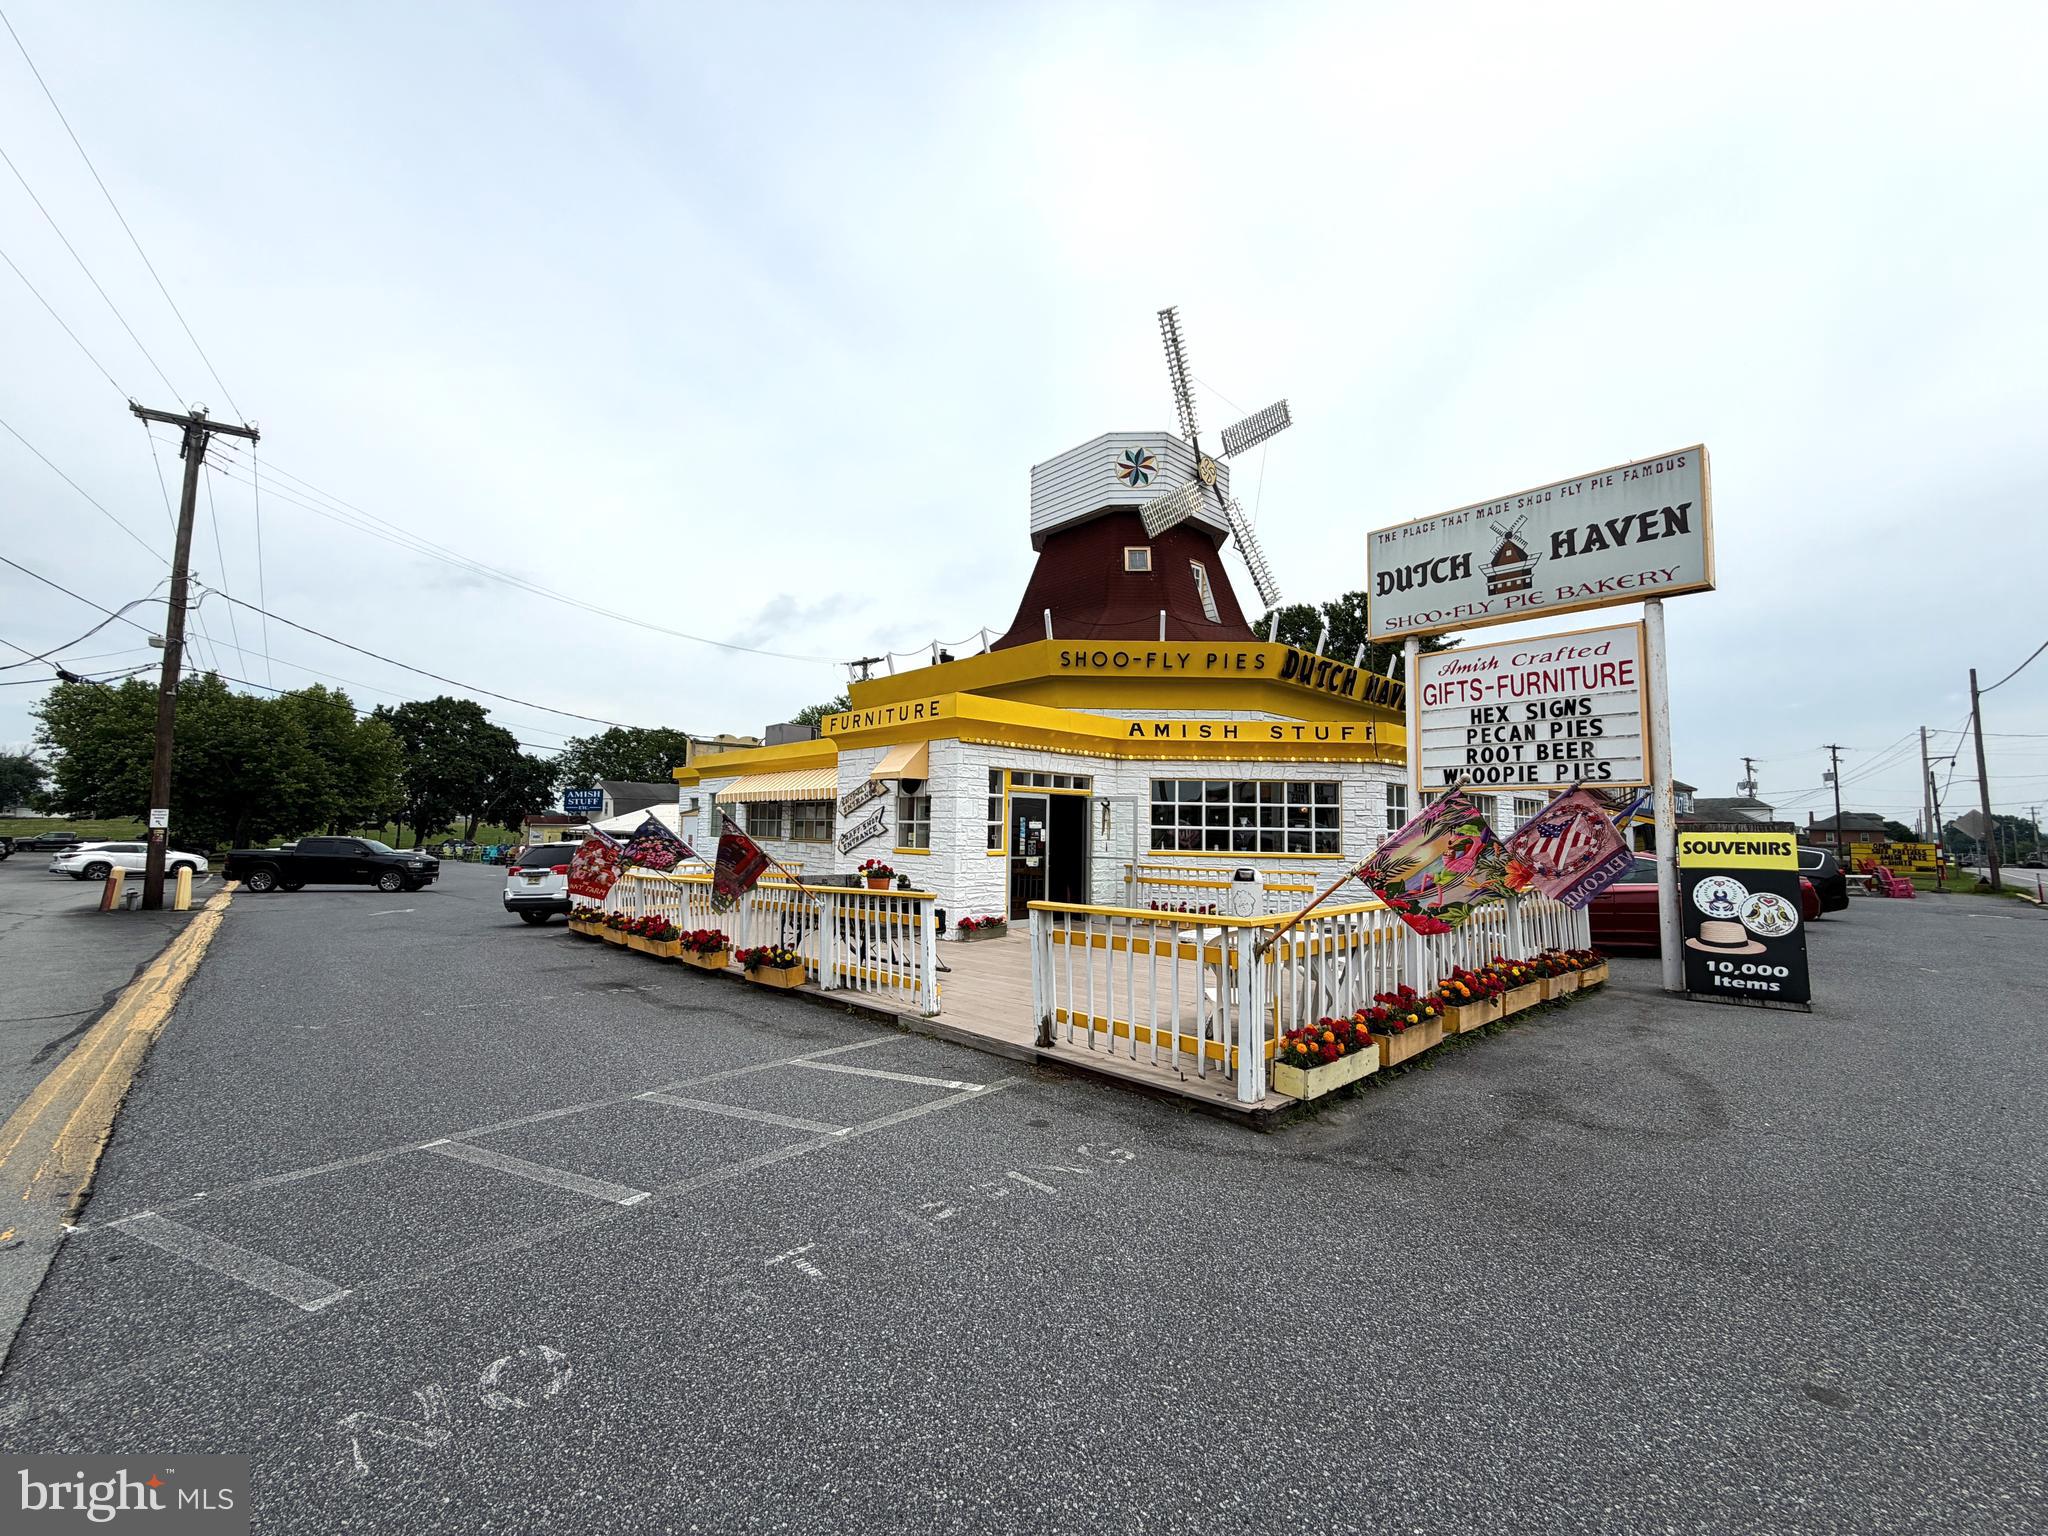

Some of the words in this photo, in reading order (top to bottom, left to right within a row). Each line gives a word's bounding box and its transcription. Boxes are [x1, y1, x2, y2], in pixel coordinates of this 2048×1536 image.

[1378, 531, 1397, 544] THE
[1403, 521, 1436, 539] PLACE
[1441, 512, 1469, 528] THAT
[1476, 502, 1510, 520] MADE
[1518, 491, 1552, 509] SHOO
[1560, 482, 1583, 499] FLY
[1591, 475, 1614, 491] PIE
[1623, 456, 1686, 481] FAMOUS
[1376, 552, 1473, 597] DUTCH
[1549, 502, 1693, 561] HAVEN
[1505, 591, 1545, 610] PIE
[1555, 565, 1681, 600] BAKERY
[1060, 650, 1191, 669] SHOO-FLY
[1207, 653, 1265, 670] PIES
[1438, 655, 1500, 677] Amish
[1511, 641, 1611, 667] Crafted
[1281, 651, 1358, 696] DUTCH
[1363, 675, 1406, 710] HAV
[1423, 660, 1635, 706] GIFTS-FURNITURE
[830, 701, 940, 732] FURNITURE
[1470, 705, 1509, 725] HEX
[1526, 698, 1592, 720] SIGNS
[1129, 723, 1238, 739] AMISH
[1270, 725, 1375, 740] STUFF
[1467, 724, 1536, 745] PECAN
[1550, 719, 1603, 739] PIES
[1466, 746, 1524, 764] ROOT
[1537, 741, 1595, 761] BEER
[1556, 762, 1612, 781] PIES
[567, 790, 600, 798] AMISH
[863, 815, 879, 830] SHOP
[843, 825, 878, 850] ENTRANCE
[1683, 841, 1792, 856] SOUVENIRS
[585, 886, 606, 896] FARM
[1706, 960, 1789, 978] 10,000
[1714, 975, 1781, 991] Items
